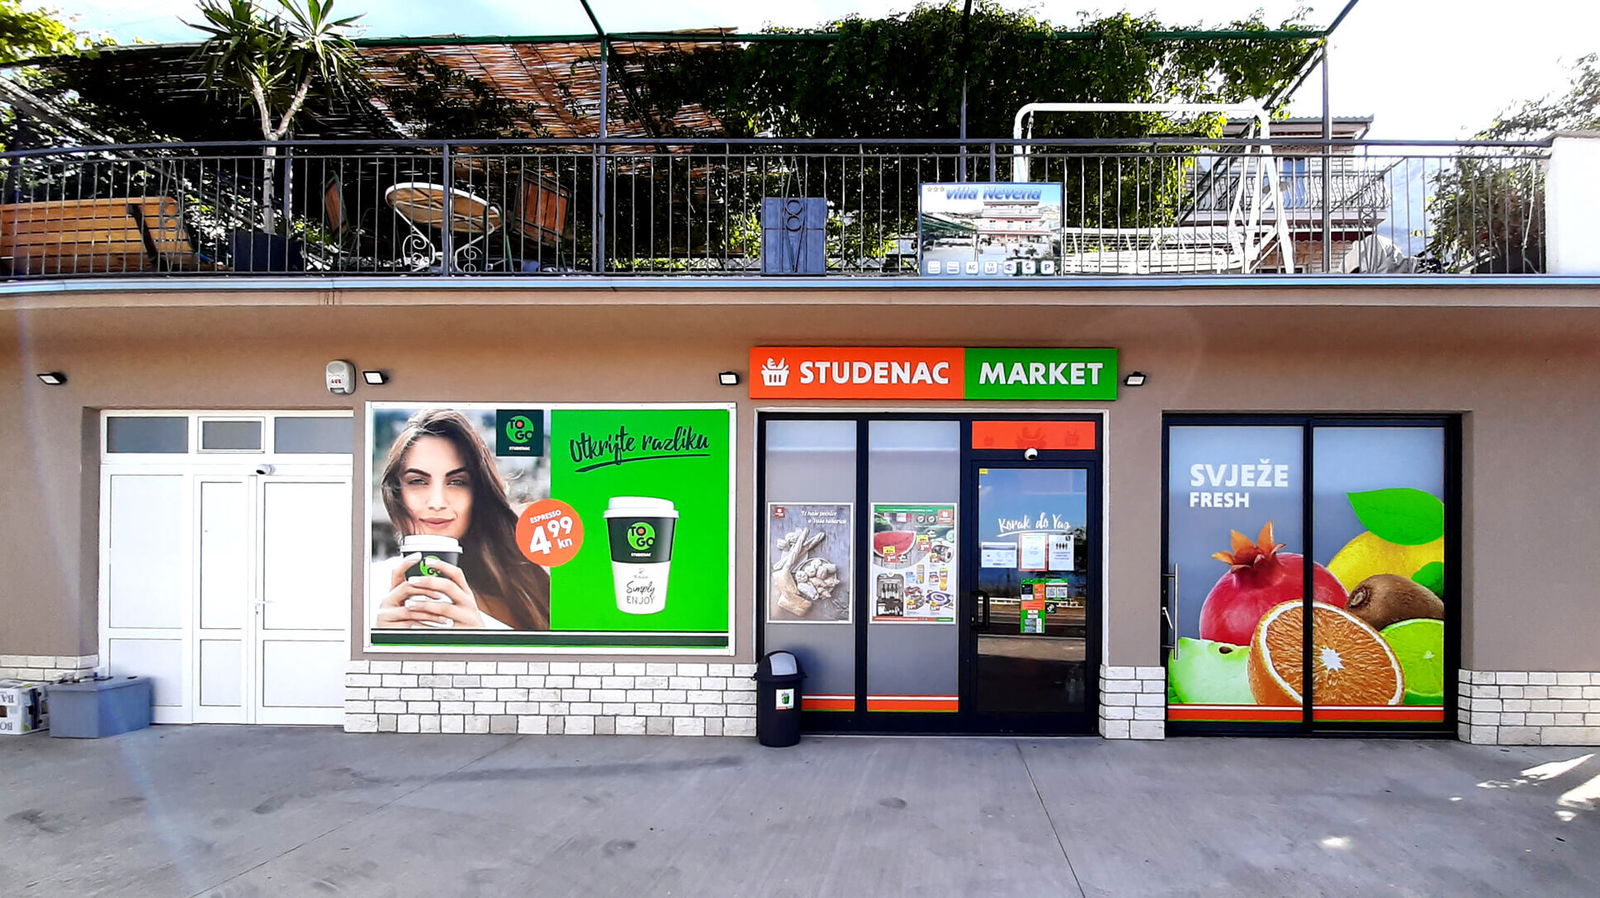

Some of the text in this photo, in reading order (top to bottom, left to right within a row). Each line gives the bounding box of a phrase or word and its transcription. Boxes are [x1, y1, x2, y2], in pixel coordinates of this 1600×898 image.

[800, 361, 1104, 386] STUDENAC MARKET
[509, 418, 525, 430] TO
[515, 430, 534, 440] GO
[641, 425, 710, 452] razliku
[1190, 458, 1289, 487] SVJEŽE
[1189, 492, 1250, 508] FRESH
[529, 509, 562, 524] ESPRESSO
[1035, 511, 1049, 529] do
[628, 526, 646, 537] TO
[557, 538, 573, 549] kn
[636, 537, 655, 547] GO
[626, 595, 656, 605] ENJOY
